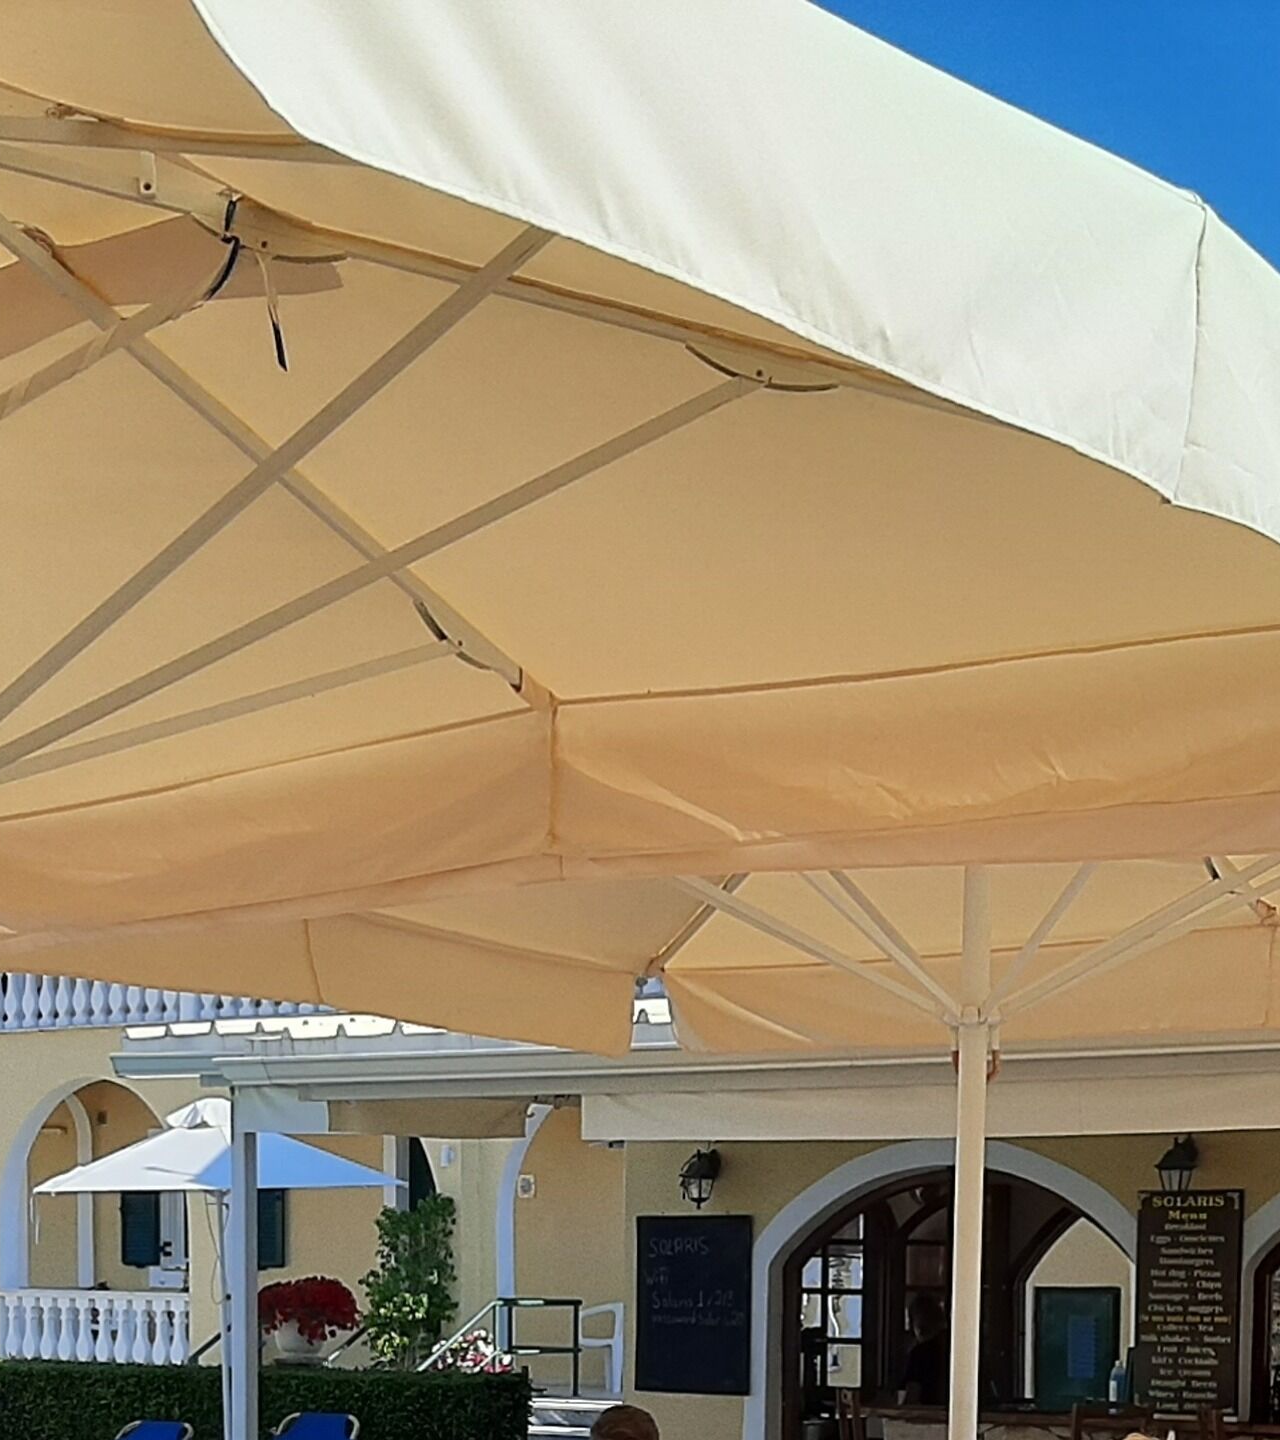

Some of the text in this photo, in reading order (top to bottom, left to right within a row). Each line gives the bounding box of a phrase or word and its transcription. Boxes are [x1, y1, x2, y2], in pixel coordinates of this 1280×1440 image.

[1151, 1195, 1225, 1208] SOLARIS
[1167, 1209, 1208, 1221] Menu
[648, 1236, 710, 1258] SOLARIS
[1147, 1303, 1184, 1312] Chicken
[1198, 1324, 1214, 1332] Tea
